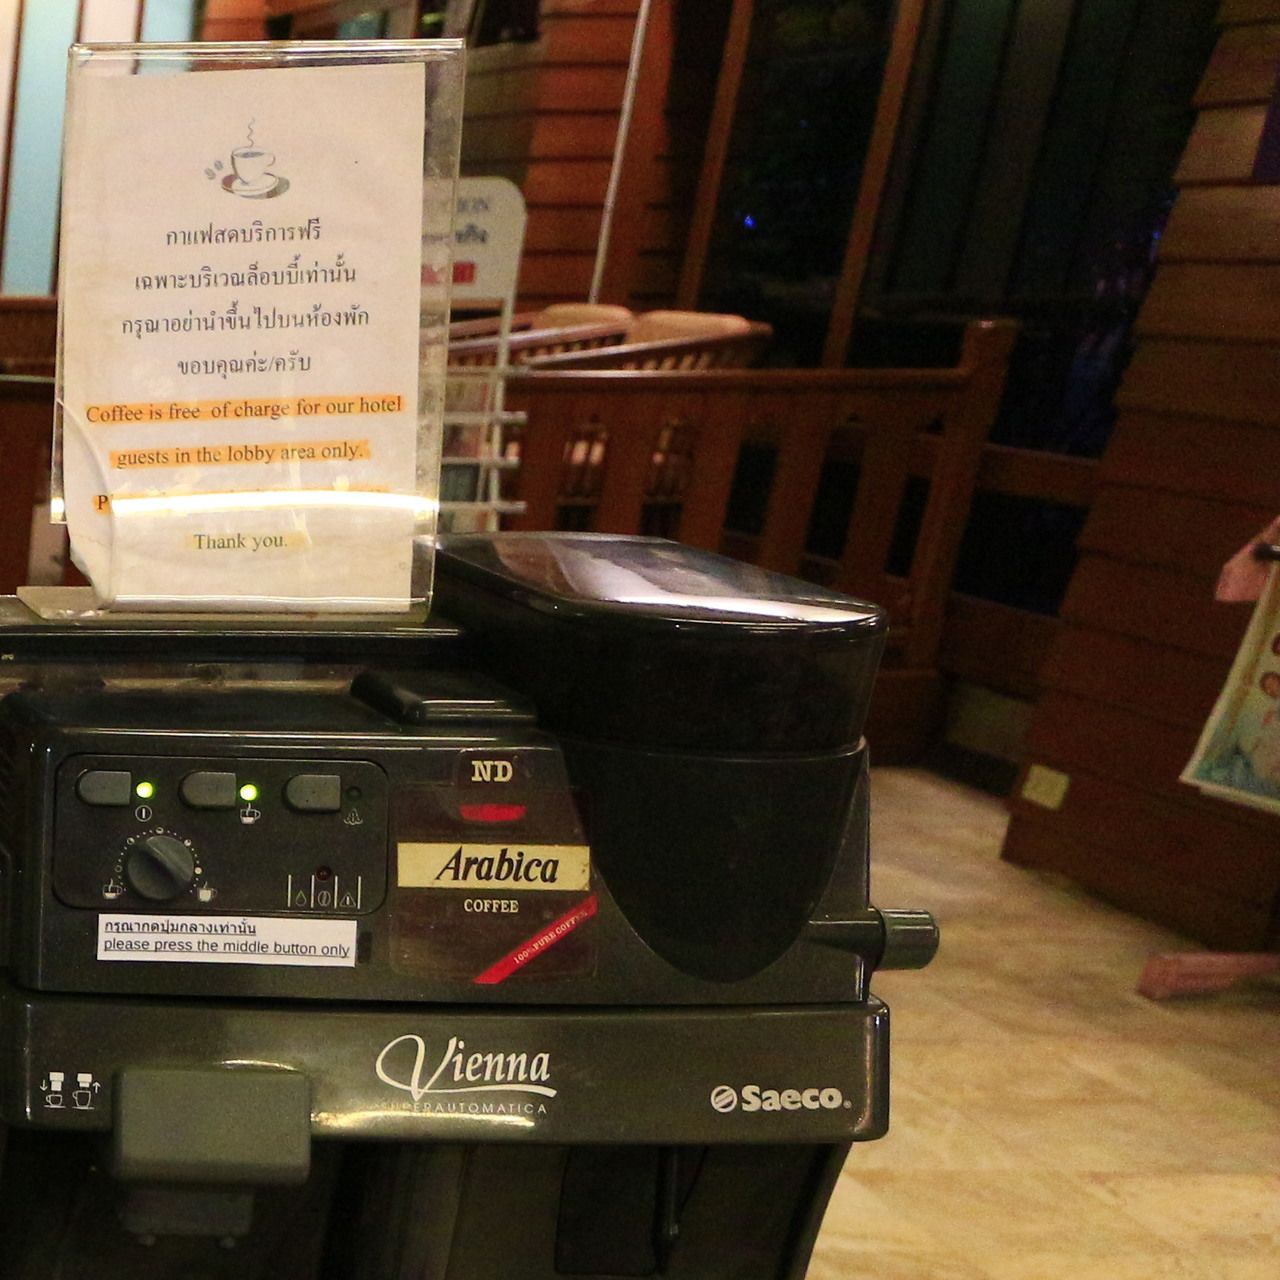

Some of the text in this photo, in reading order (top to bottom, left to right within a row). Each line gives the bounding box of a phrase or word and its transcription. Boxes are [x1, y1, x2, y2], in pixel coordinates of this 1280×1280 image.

[166, 217, 321, 246] กาแฟสดบริการฟรี
[86, 396, 402, 423] Coffee is free of charge for our hotel
[117, 442, 363, 470] guests in the lobby area only.
[194, 534, 287, 552] Thank you.
[471, 760, 513, 783] ND
[435, 845, 559, 883] Arabica
[464, 899, 519, 913] COFFEE
[104, 939, 350, 958] please press the middle button only
[376, 1034, 557, 1101] Vienna
[741, 1085, 843, 1111] Saeco
